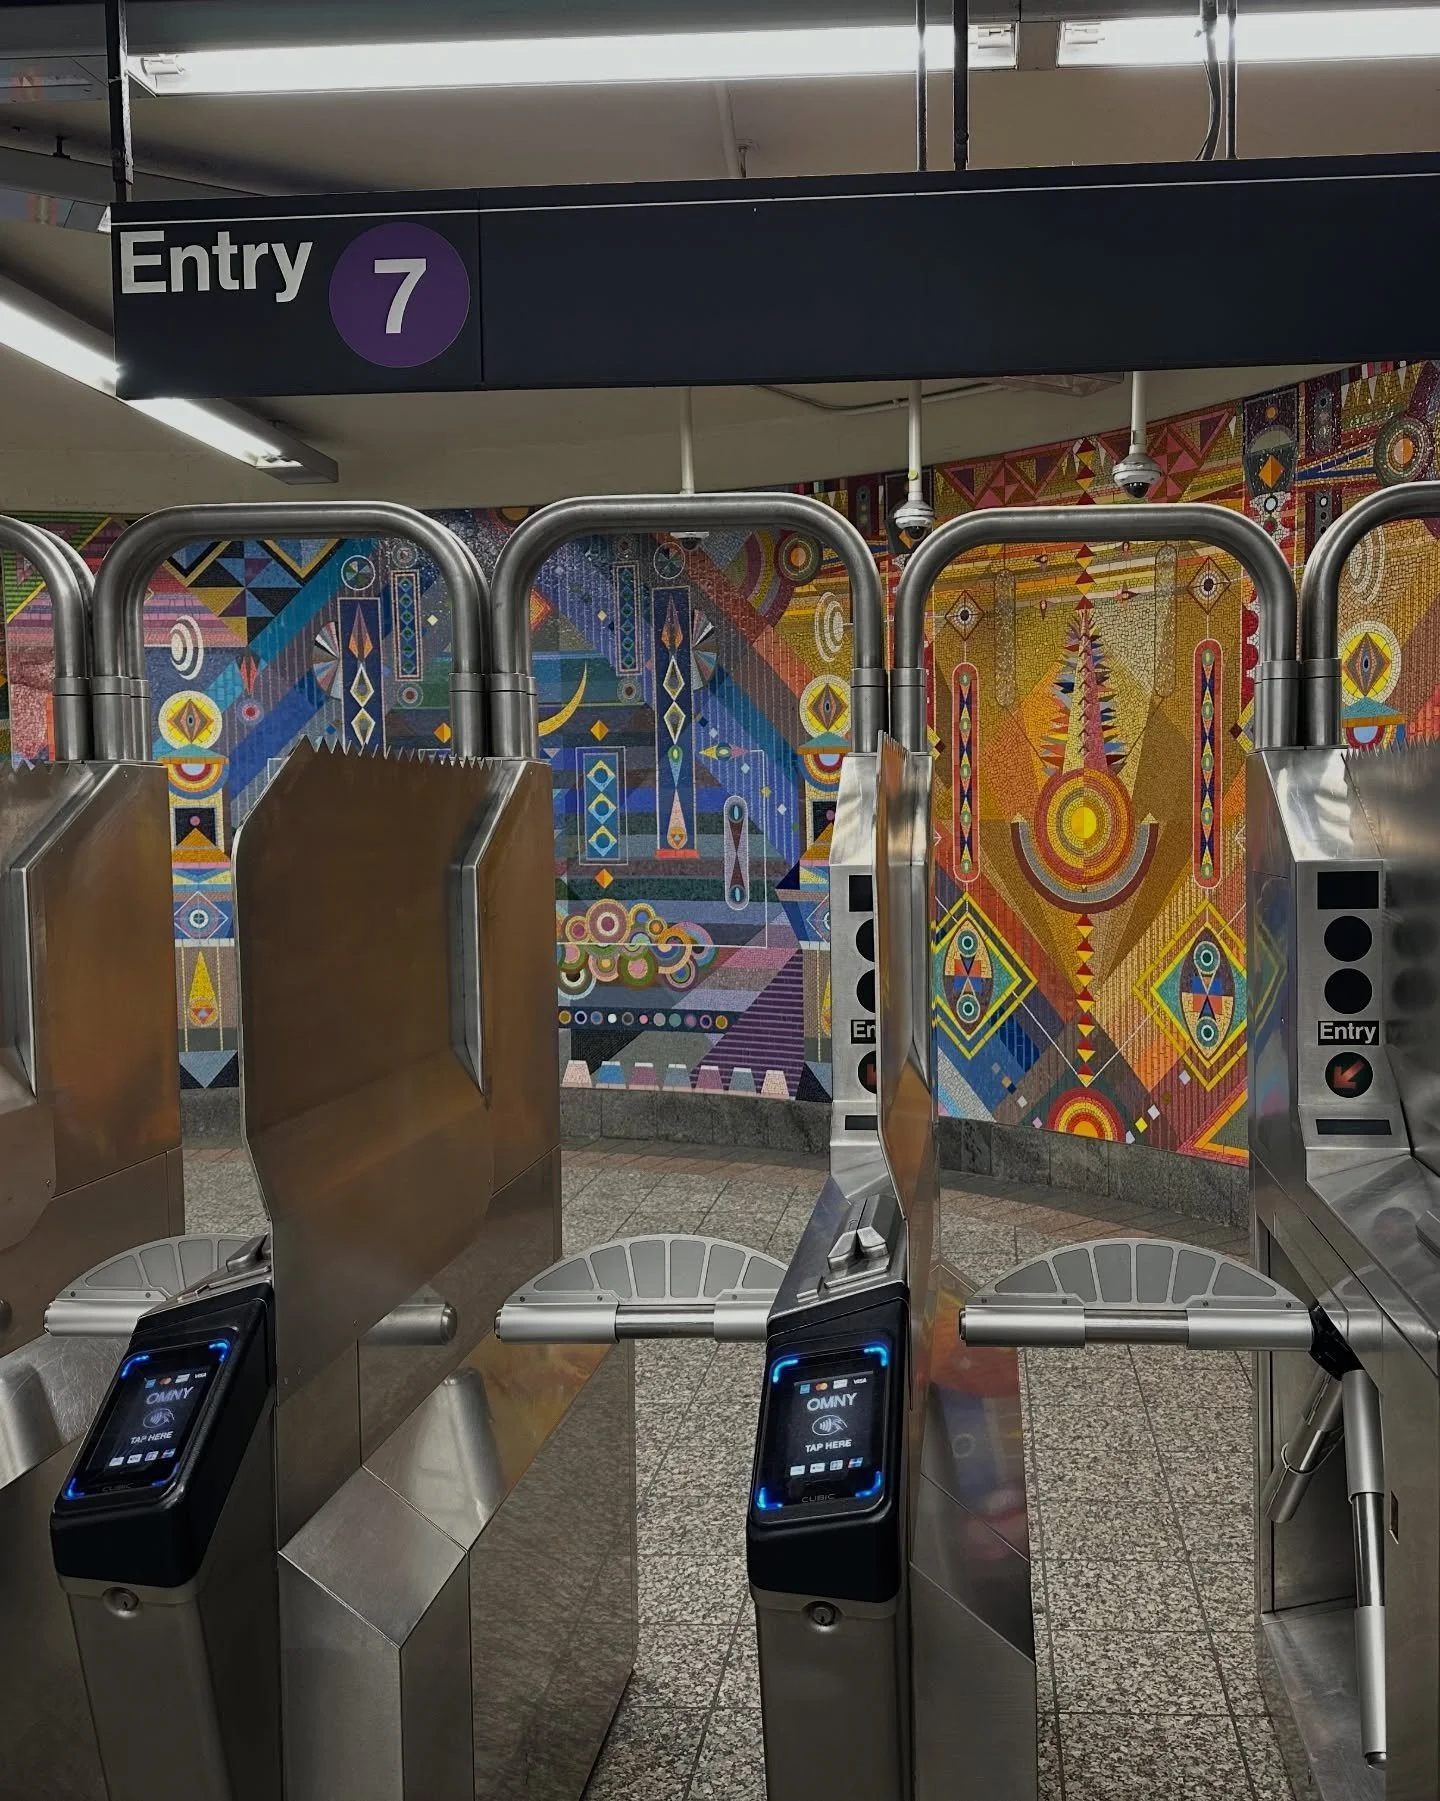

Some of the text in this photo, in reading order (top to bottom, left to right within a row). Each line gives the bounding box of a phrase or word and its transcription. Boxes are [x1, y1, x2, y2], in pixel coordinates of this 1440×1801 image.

[120, 230, 428, 335] Entry 7
[1320, 1022, 1376, 1044] Entry
[146, 1386, 194, 1405] OMNY
[806, 1392, 858, 1411] OMNY
[130, 1431, 174, 1444] TAP HERE
[805, 1439, 852, 1453] TAP HERE
[801, 1493, 836, 1503] CUBIC
